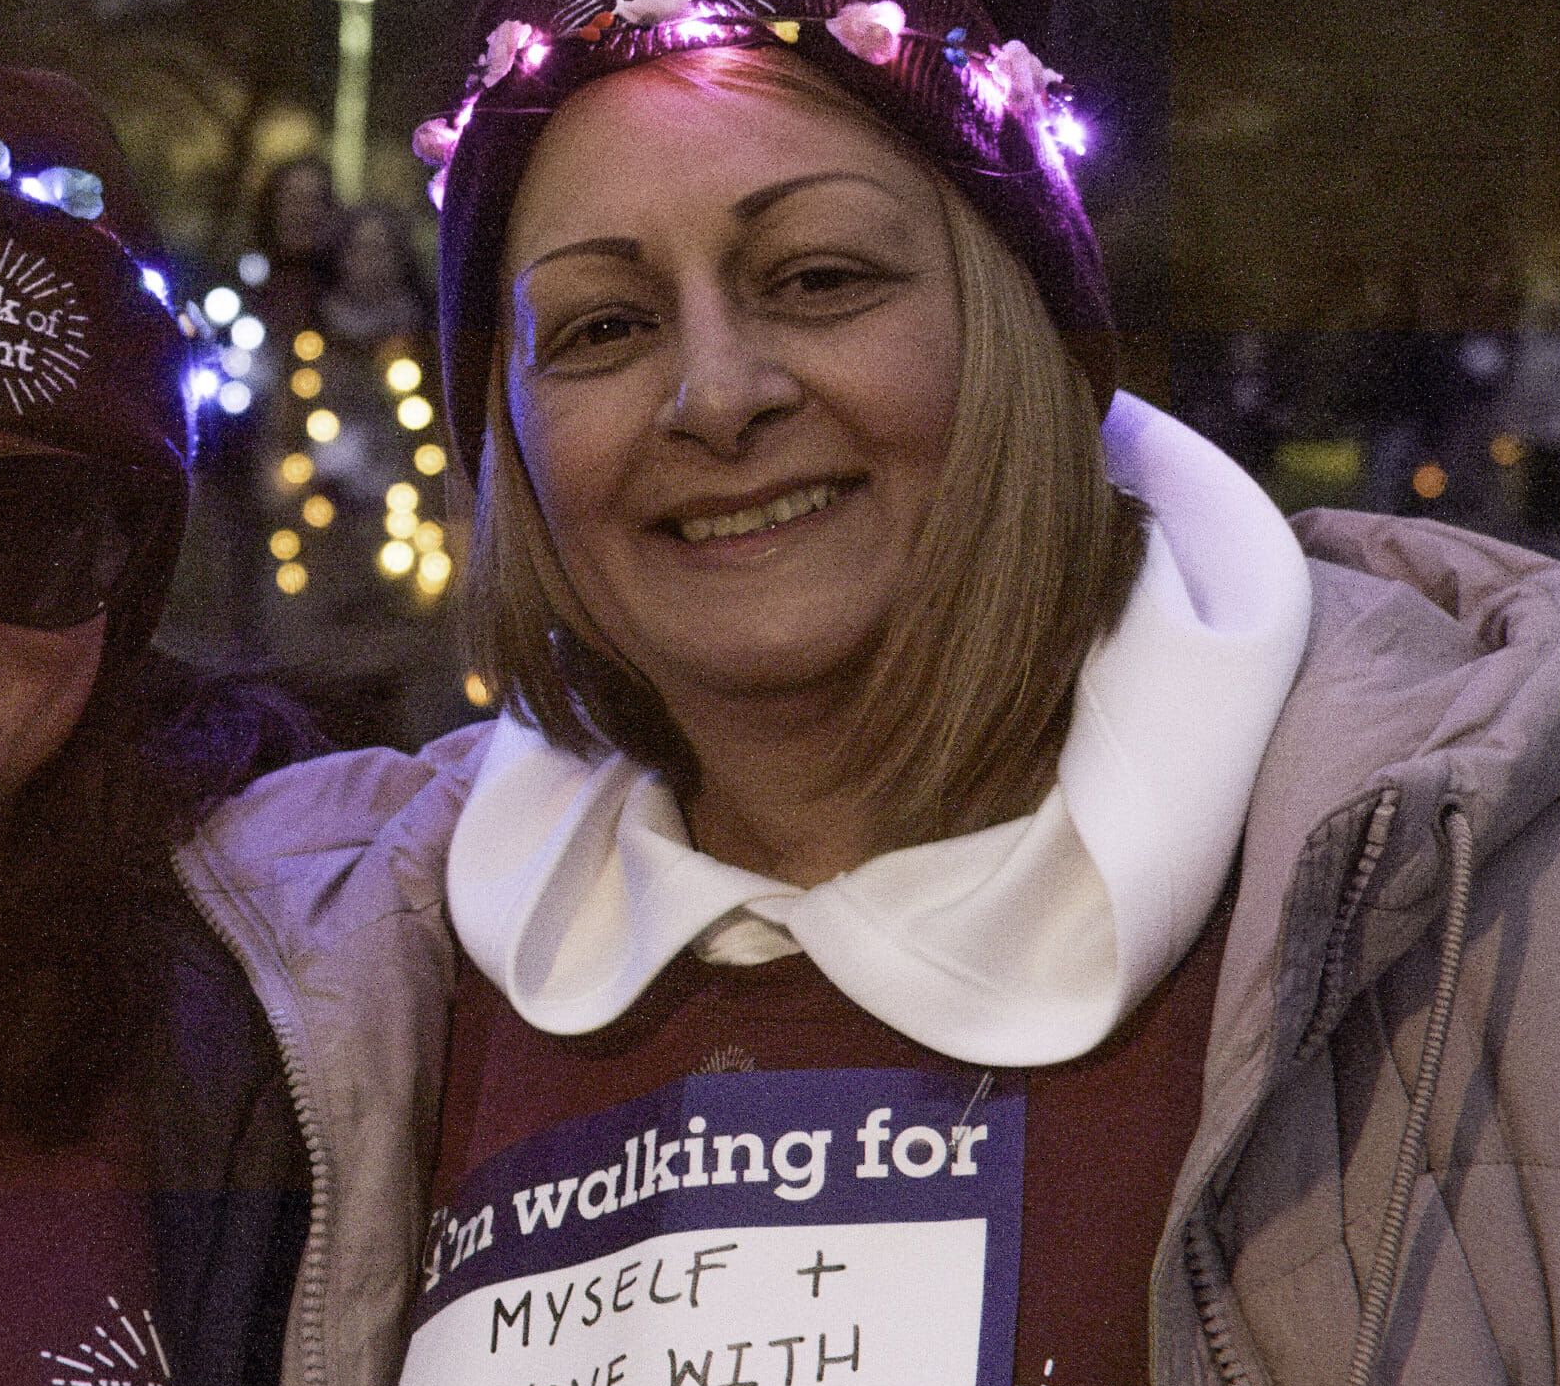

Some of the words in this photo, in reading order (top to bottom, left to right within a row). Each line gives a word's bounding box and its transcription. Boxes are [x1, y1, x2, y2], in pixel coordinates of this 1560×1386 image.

[26, 309, 63, 338] of
[513, 1116, 832, 1235] walking
[855, 1108, 988, 1180] for
[489, 1243, 738, 1353] MYSELF
[796, 1250, 847, 1299] +
